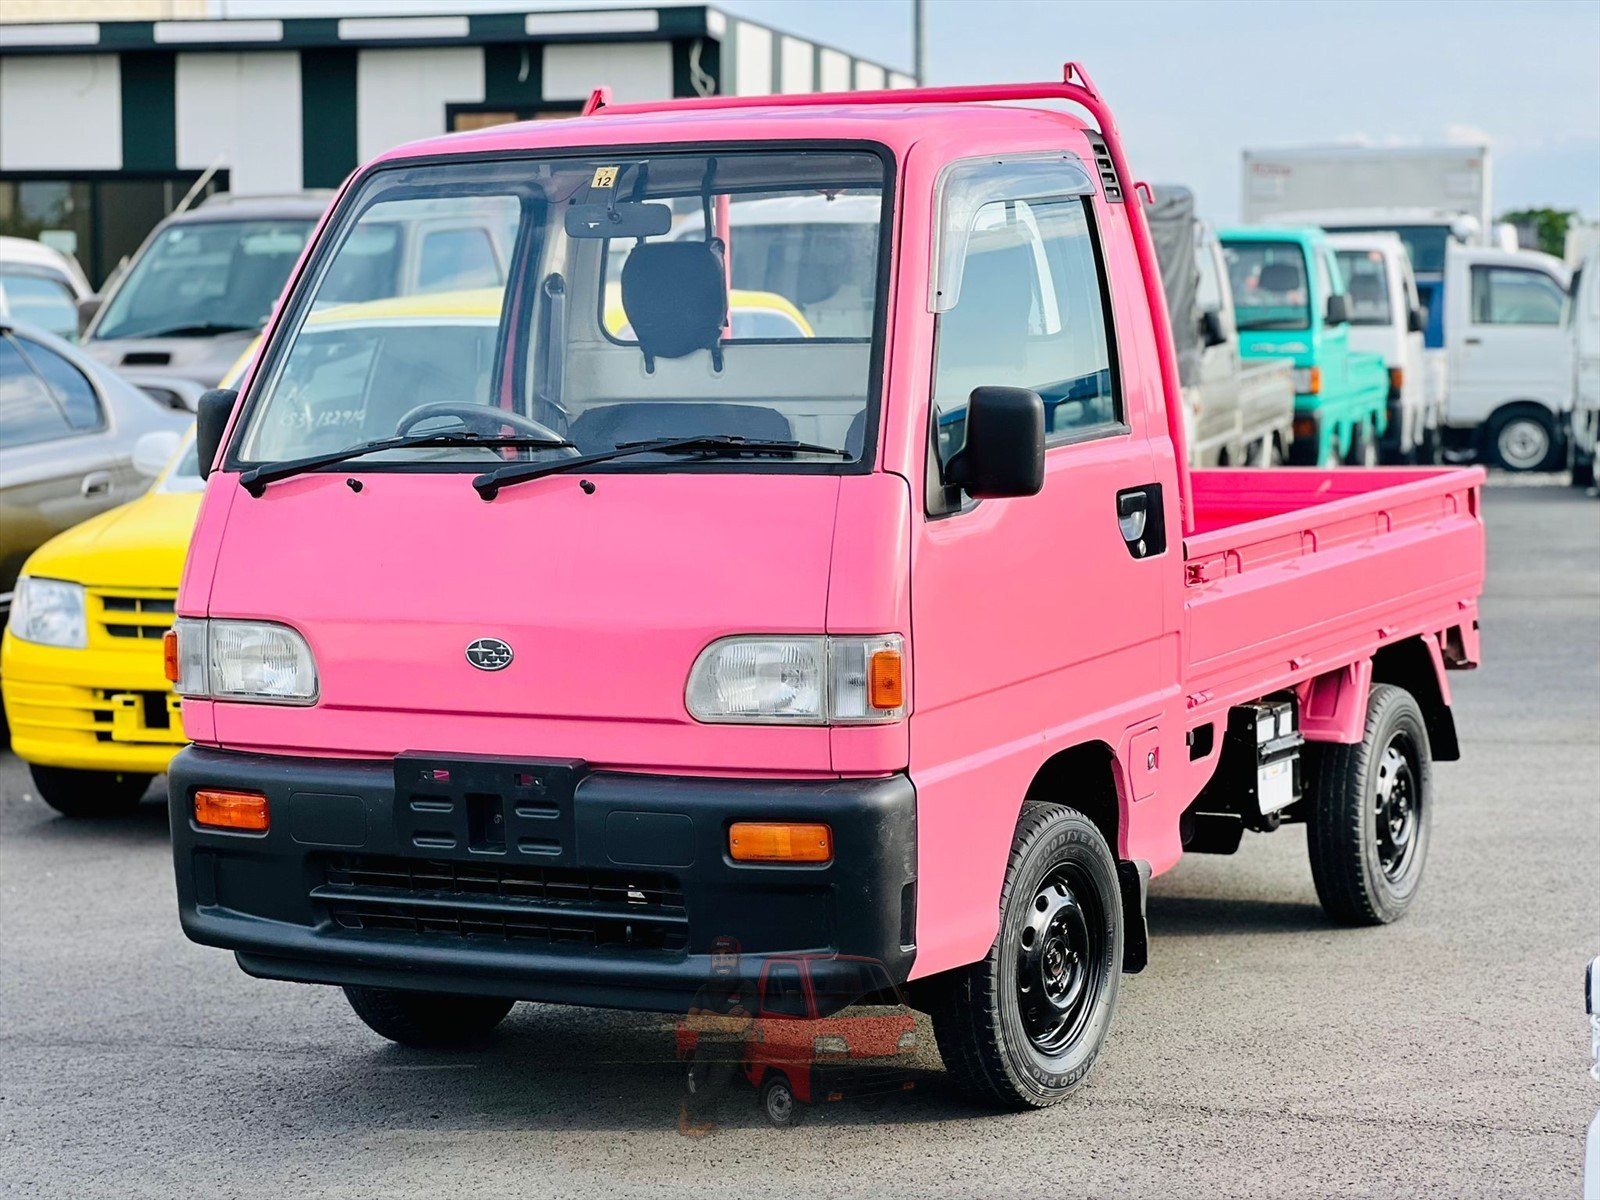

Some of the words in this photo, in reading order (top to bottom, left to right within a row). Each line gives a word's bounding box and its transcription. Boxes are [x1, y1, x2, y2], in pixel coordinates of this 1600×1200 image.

[597, 176, 612, 187] 12
[1037, 830, 1103, 868] GOODYEAR
[1033, 1067, 1056, 1087] PRO
[1060, 1050, 1096, 1087] CARGO
